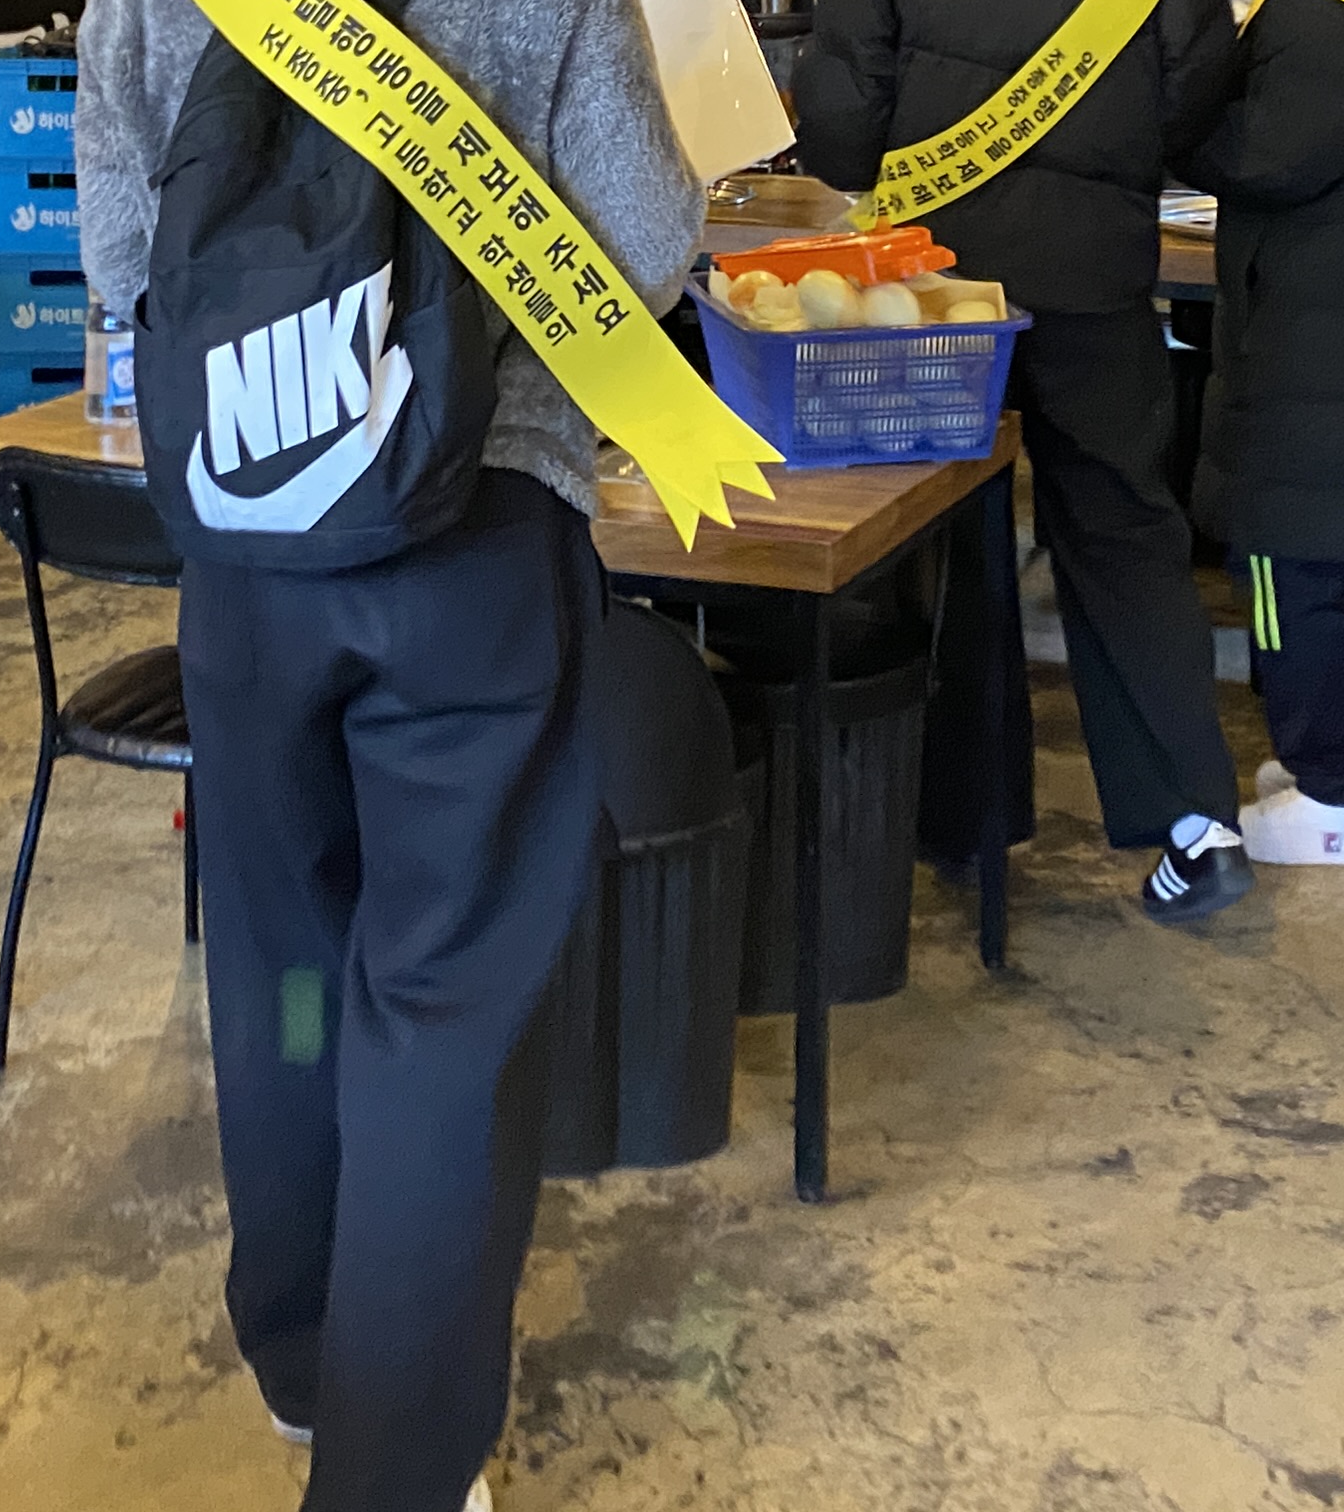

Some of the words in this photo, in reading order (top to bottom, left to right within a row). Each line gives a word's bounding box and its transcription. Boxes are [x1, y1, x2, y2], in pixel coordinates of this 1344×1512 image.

[914, 113, 999, 172] 고등학교
[984, 52, 1099, 163] 일탈행동을
[259, 23, 369, 107] 조종중,
[364, 110, 483, 236] 고등학교
[477, 233, 578, 347] 학생들의
[877, 192, 906, 216] 주세
[911, 158, 984, 207] 제보해
[447, 120, 551, 231] 제보해
[543, 233, 631, 336] 주세요
